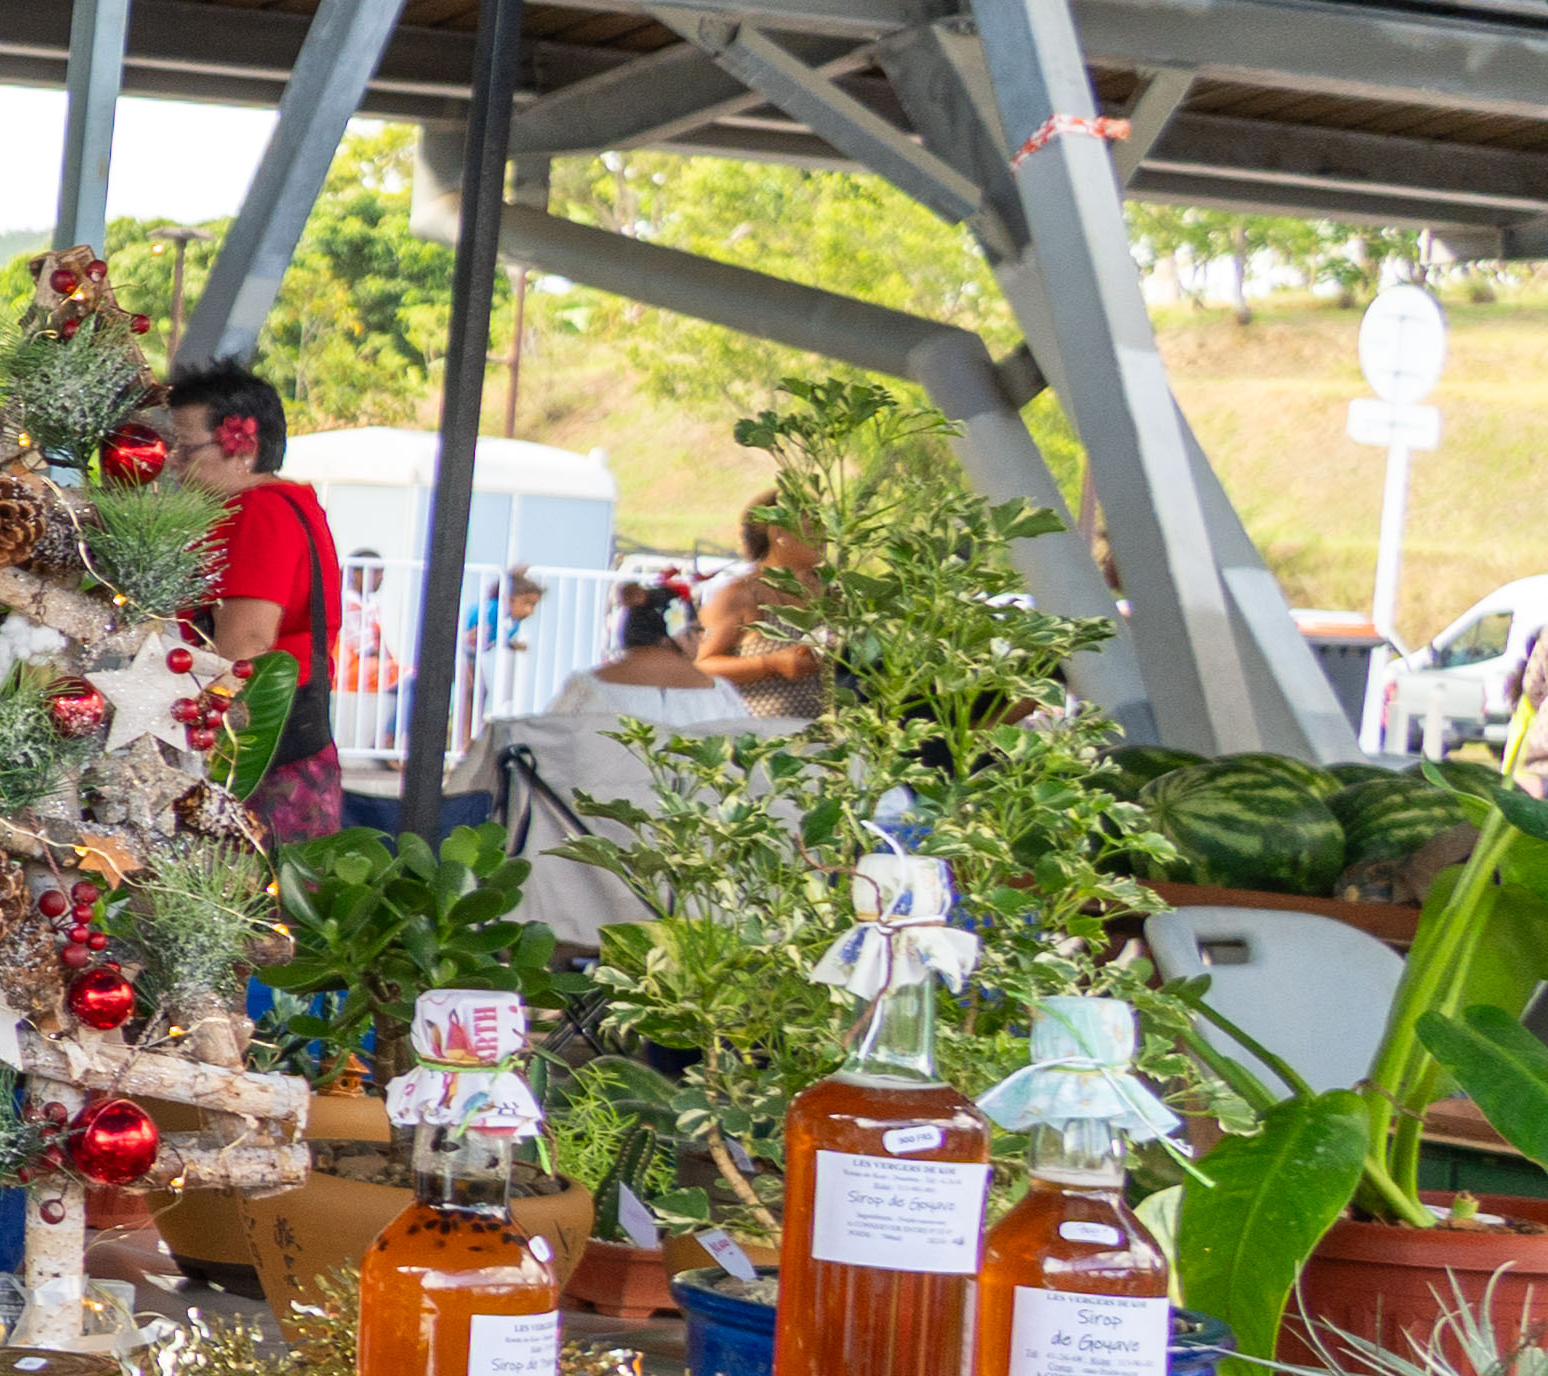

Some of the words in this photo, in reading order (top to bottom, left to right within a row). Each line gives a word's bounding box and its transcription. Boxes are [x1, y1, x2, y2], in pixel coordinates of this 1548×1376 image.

[924, 1166, 935, 1174] DE
[847, 1190, 884, 1205] Sirop
[888, 1195, 904, 1208] de
[1077, 1309, 1123, 1330] Sirop
[1051, 1330, 1072, 1346] de
[1078, 1334, 1140, 1354] Goyave
[492, 1358, 524, 1372] Sirop
